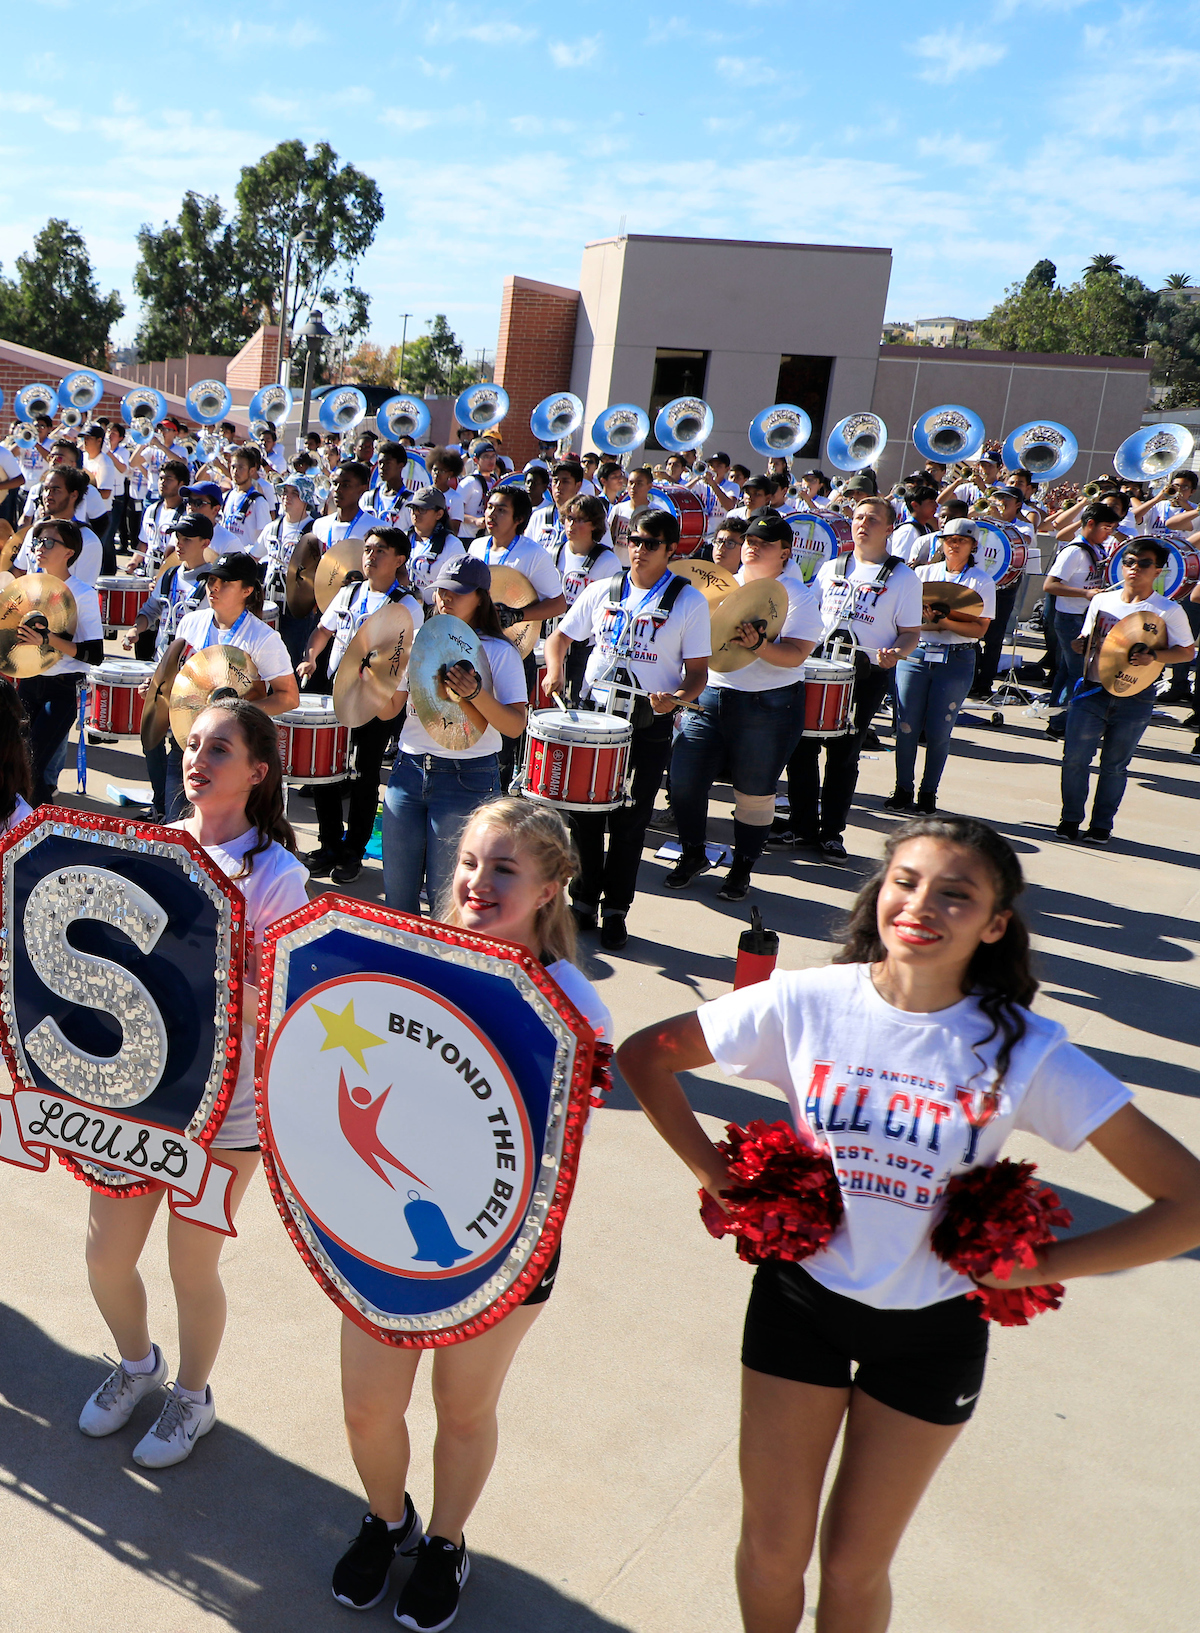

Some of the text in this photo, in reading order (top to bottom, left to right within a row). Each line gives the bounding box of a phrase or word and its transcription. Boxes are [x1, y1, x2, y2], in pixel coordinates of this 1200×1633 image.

[691, 566, 730, 591] Zildjian
[389, 629, 406, 677] Zildjian
[448, 633, 474, 655] Zildjian
[634, 651, 658, 662] BAND
[229, 662, 252, 687] Zildjian
[99, 699, 108, 730] YAMAHA
[549, 761, 563, 796] YAMAHA
[847, 1065, 946, 1092] LOS ANGELES
[388, 1012, 516, 1239] BEYOND THE BELL
[806, 1059, 1002, 1166] ALL CITY
[28, 1099, 189, 1178] LAUSD
[835, 1145, 936, 1180] EST. 1972
[837, 1168, 908, 1199] CHING
